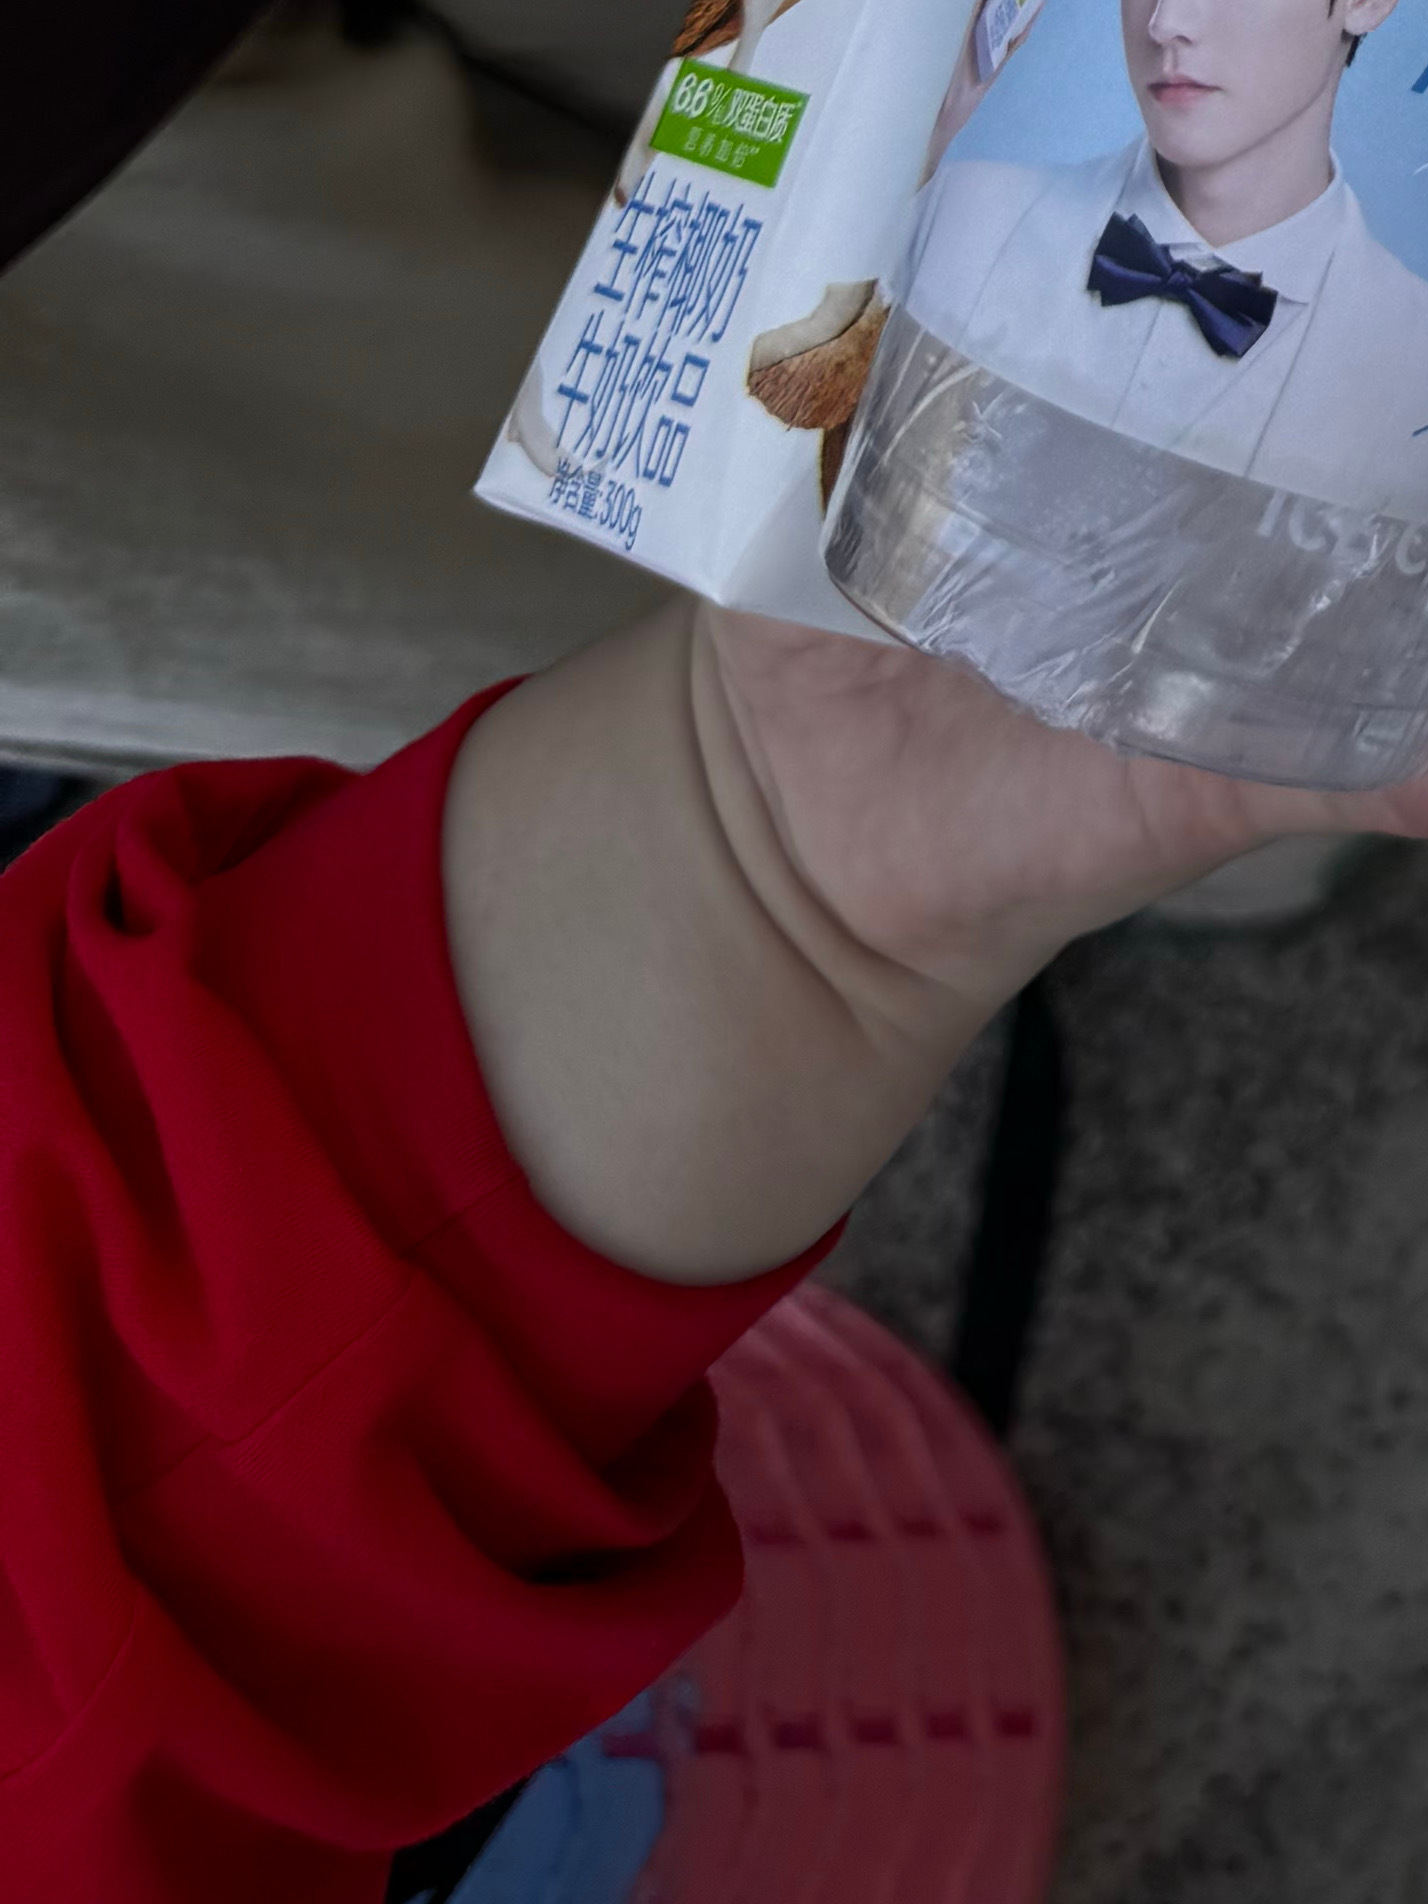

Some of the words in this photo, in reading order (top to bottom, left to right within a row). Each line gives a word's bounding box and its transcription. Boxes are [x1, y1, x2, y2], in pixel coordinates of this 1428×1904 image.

[594, 170, 764, 344] 生榨椰奶
[556, 308, 711, 489] 牛奶饮品
